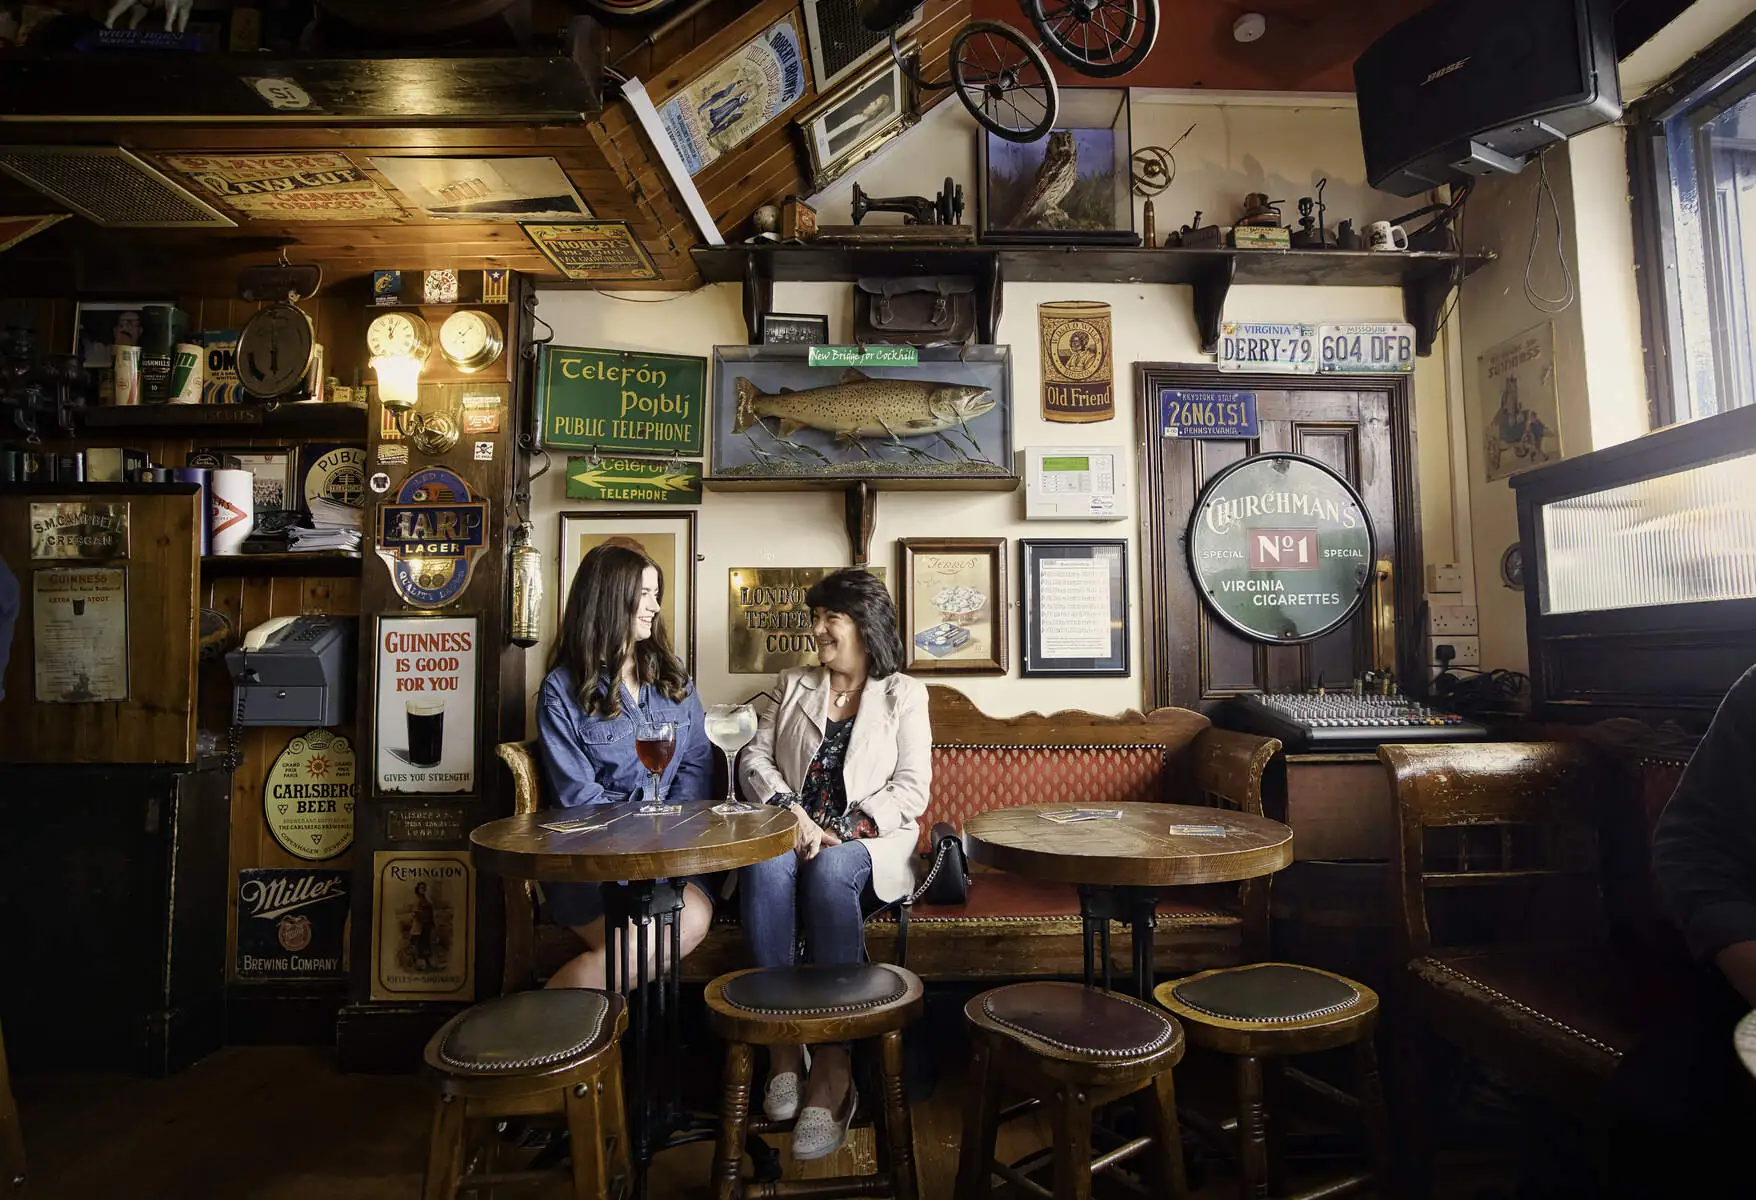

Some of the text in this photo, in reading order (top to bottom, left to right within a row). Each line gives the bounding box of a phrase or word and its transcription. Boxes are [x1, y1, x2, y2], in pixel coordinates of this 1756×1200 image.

[769, 31, 797, 64] ROBERT
[1244, 325, 1291, 336] VIRGINIA
[811, 350, 831, 361] New
[832, 349, 859, 366] Bridge
[876, 349, 915, 361] Cockhill
[1224, 338, 1312, 362] DERRY-79
[1322, 336, 1411, 362] 604 DFB
[209, 350, 237, 371] OM
[1048, 385, 1111, 407] Old Friend
[554, 416, 693, 442] PUBLIC TELEPHONE
[1184, 427, 1238, 435] PENNSYLVANIA
[317, 451, 360, 472] PUBL
[600, 488, 668, 500] TELEPHONE
[1206, 492, 1356, 534] CHURCHMAN'S
[391, 511, 481, 539] HARP
[405, 543, 460, 553] LAGER
[1203, 550, 1245, 559] SPECIAL
[1323, 549, 1363, 558] SPECIAL
[49, 573, 109, 586] GUINNESS
[1221, 580, 1285, 592] VIRGINIA
[741, 586, 809, 606] LONDO
[1253, 594, 1341, 607] CIGARETTES
[745, 610, 813, 629] TEMPE
[385, 631, 472, 653] GUINNESS
[766, 634, 818, 653] COUN
[395, 657, 460, 673] IS GOOD
[396, 676, 459, 692] FOR YOU
[384, 773, 470, 783] GIVES YOU STRENGTH
[297, 801, 337, 813] BEER
[391, 866, 462, 882] REMINGTON
[241, 876, 343, 915] Miller
[244, 954, 339, 972] BREWING COMPANY
